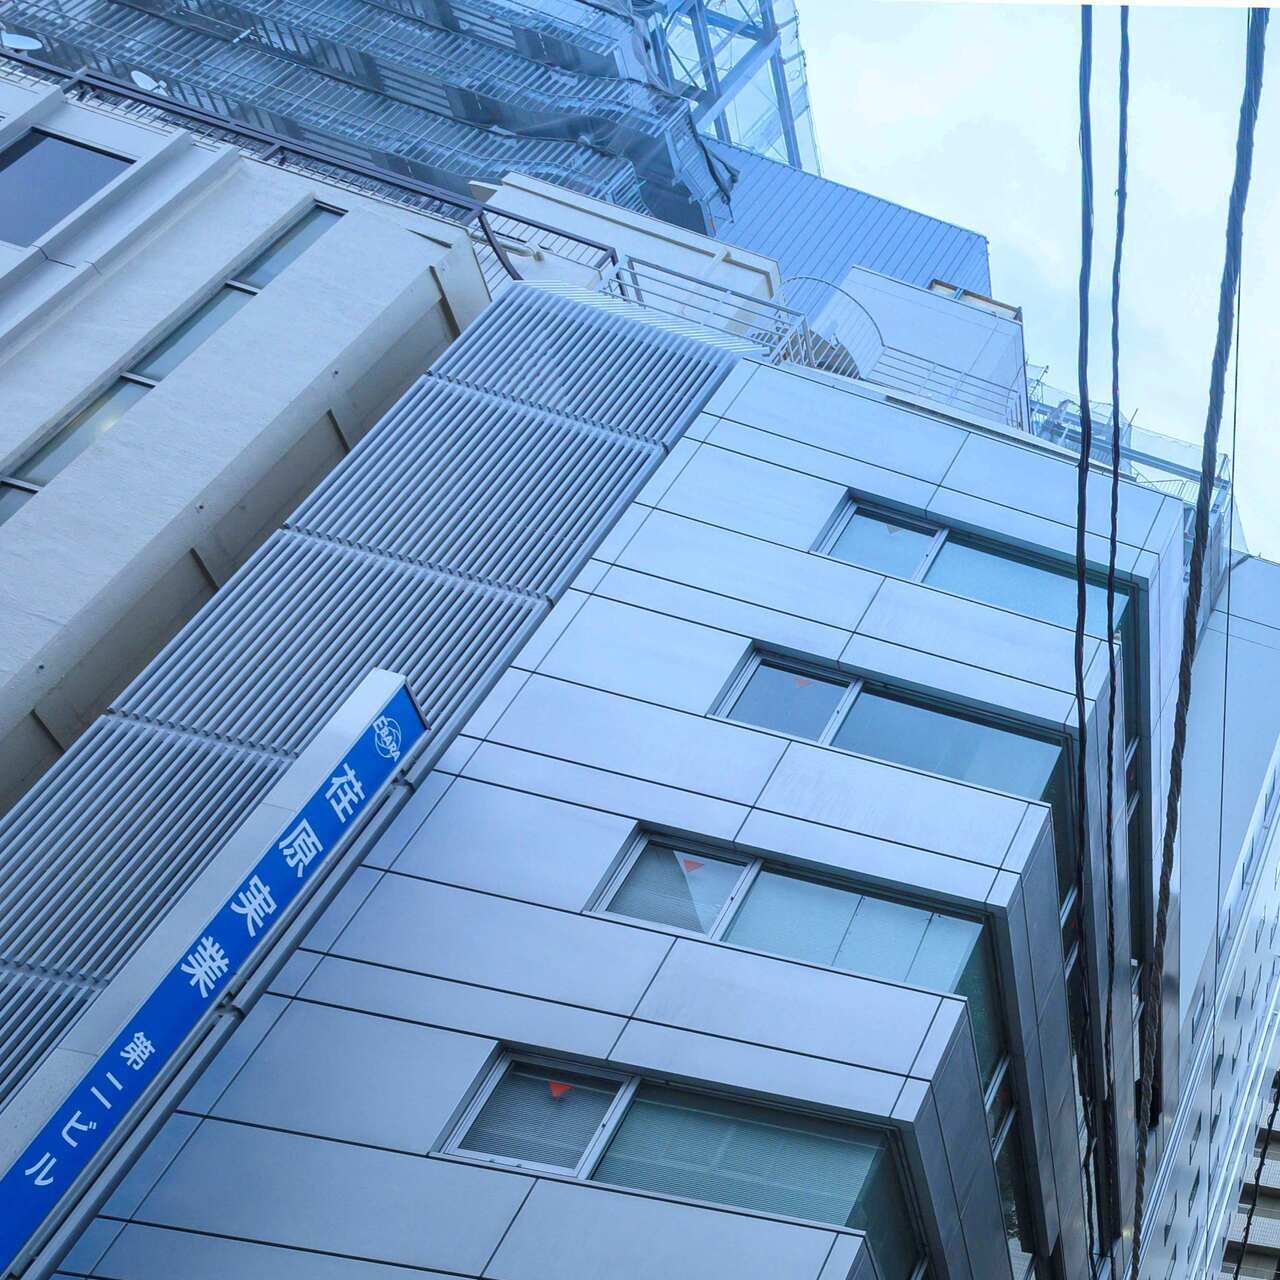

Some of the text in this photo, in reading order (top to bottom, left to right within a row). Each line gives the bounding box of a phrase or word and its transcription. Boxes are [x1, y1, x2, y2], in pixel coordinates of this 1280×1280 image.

[373, 715, 400, 762] EBARA
[25, 763, 366, 1186] 荏原実業 第二ビル
